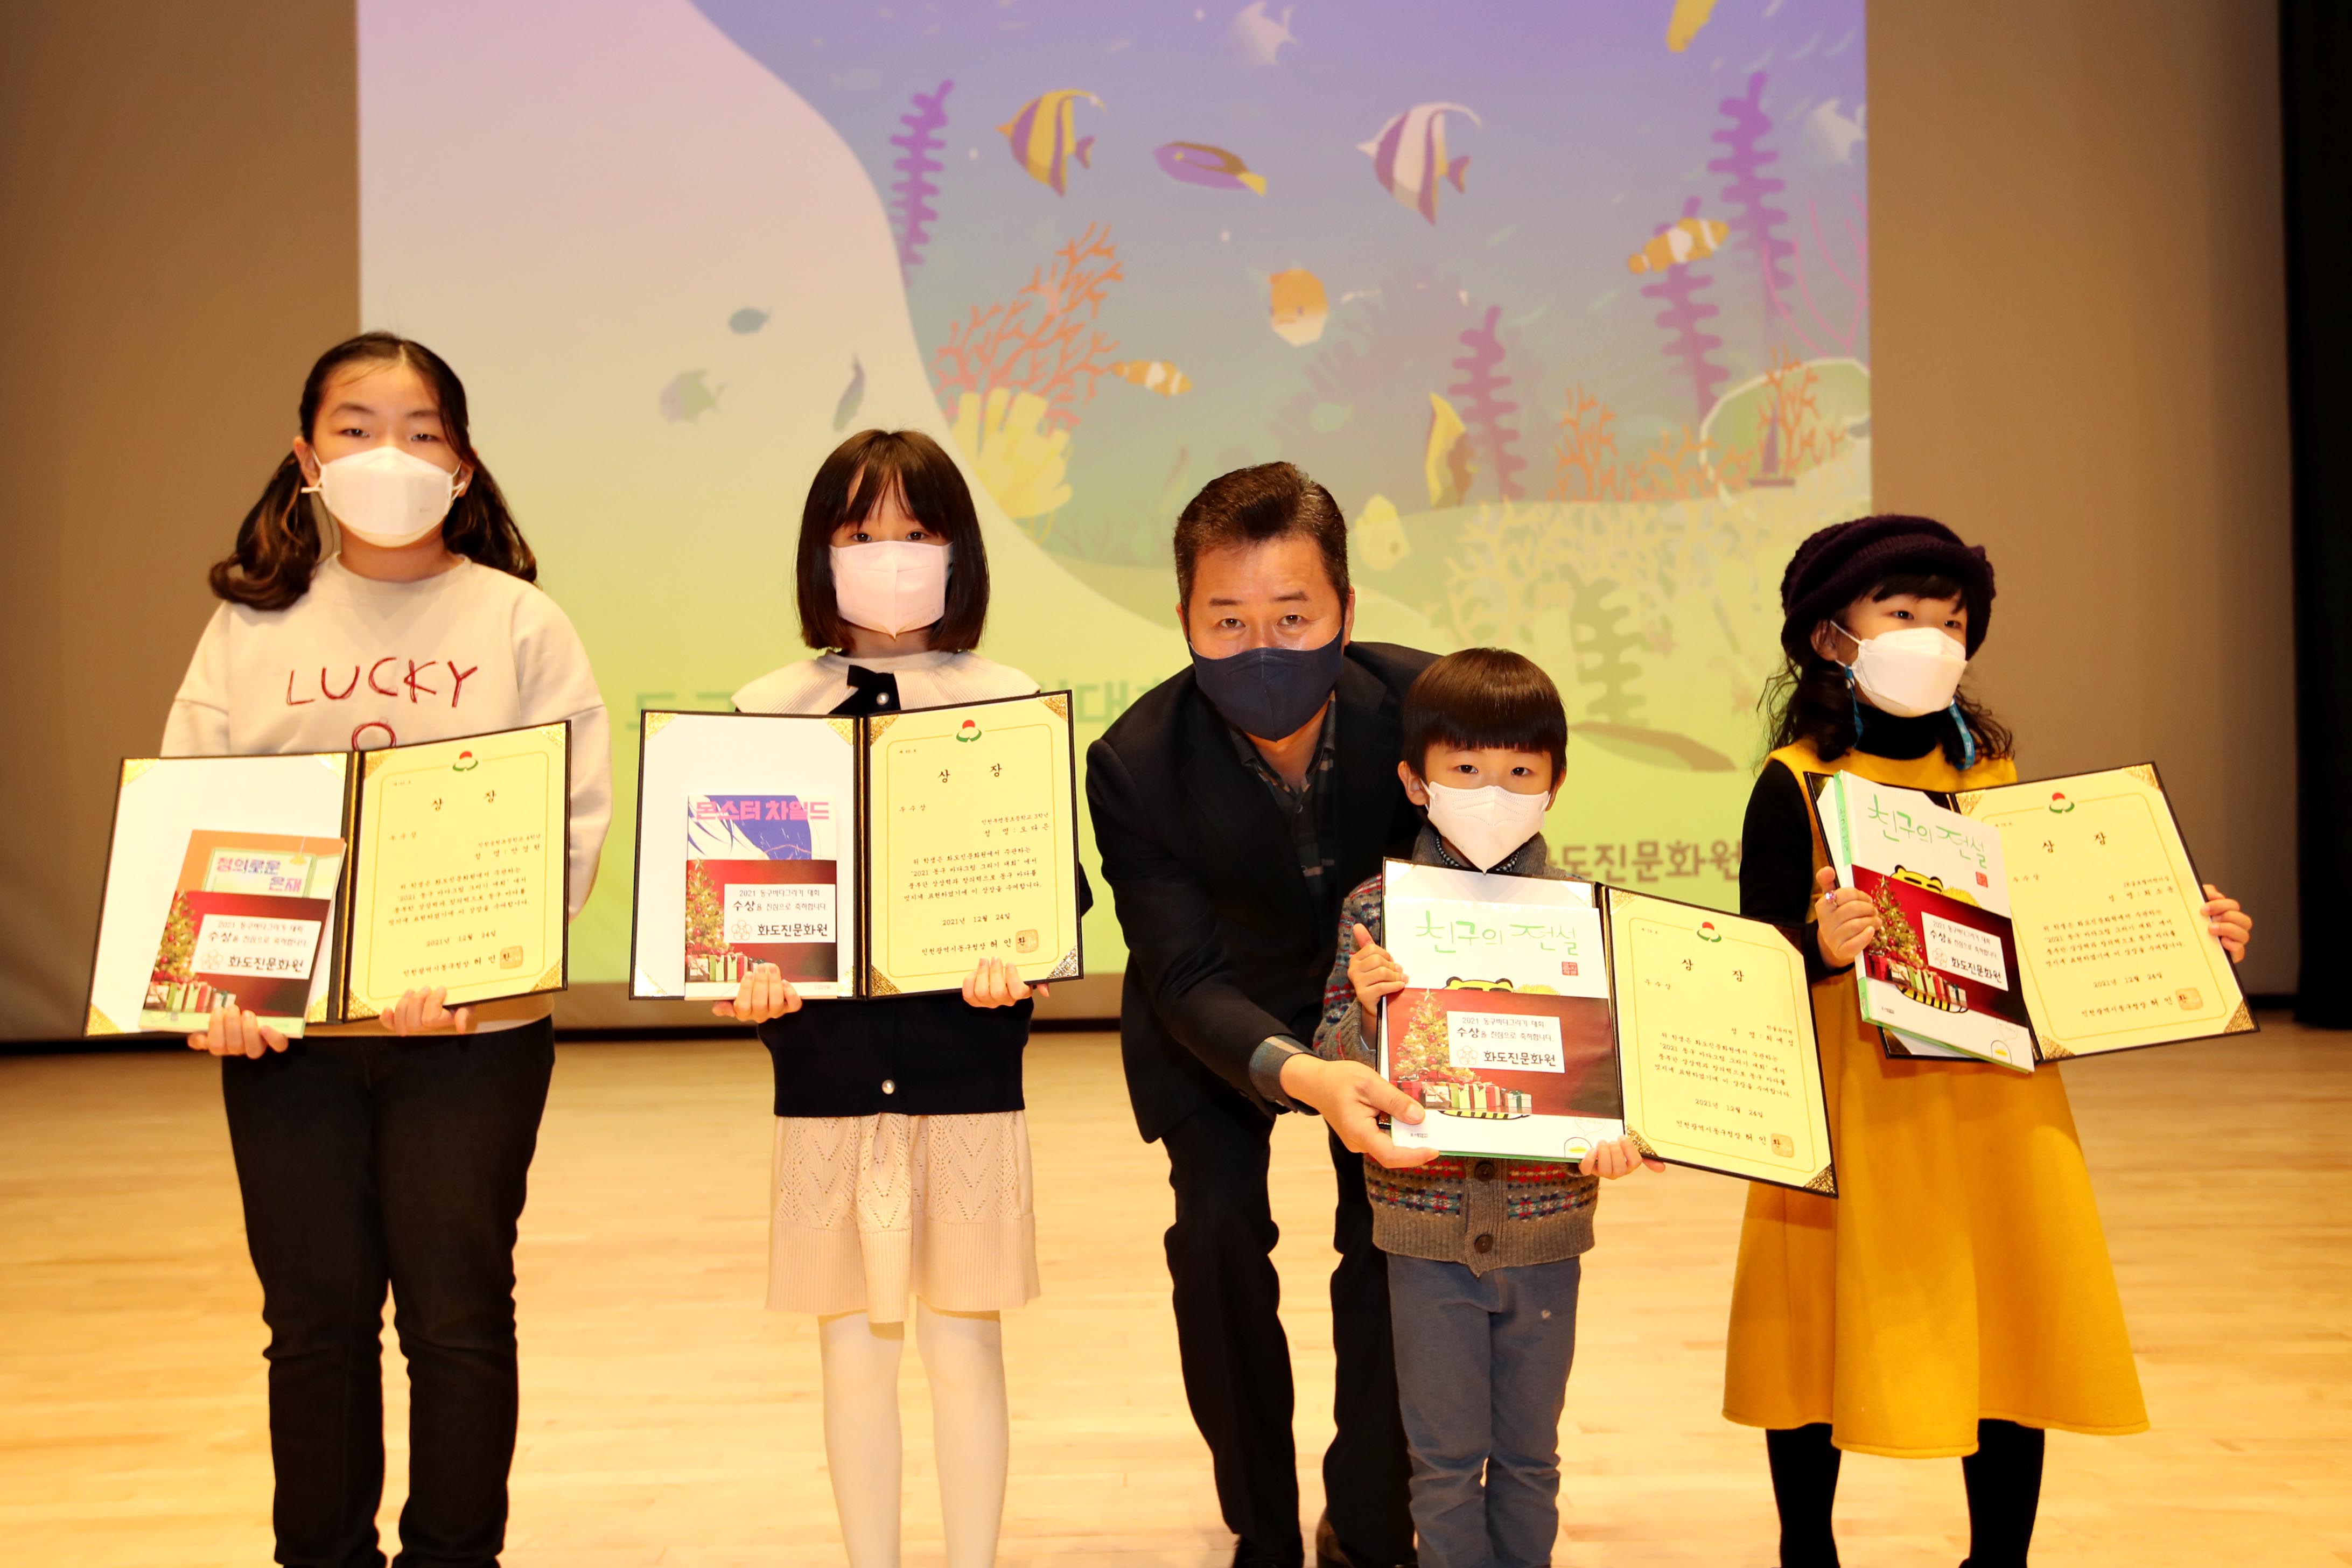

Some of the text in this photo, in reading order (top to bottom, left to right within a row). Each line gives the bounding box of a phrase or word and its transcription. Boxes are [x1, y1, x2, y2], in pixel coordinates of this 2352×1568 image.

[286, 657, 478, 708] LUCKY
[938, 763, 1002, 782] 상 장
[697, 800, 829, 821] 몬스터 차일드
[1868, 794, 1933, 844] 친구의
[1936, 825, 1987, 869] 전설
[1548, 840, 1741, 882] 도진문화원
[732, 901, 761, 911] 수상을
[758, 923, 827, 936] 화도진문화원
[942, 918, 965, 926] 2021년
[1416, 910, 1578, 955] 친구의 전설
[922, 943, 985, 955] 인천광역시동구청장
[991, 940, 997, 948] 허
[1004, 939, 1011, 947] 인
[1951, 956, 2001, 983] 화도진문화원
[1483, 1018, 1528, 1027] 동구바다그리기
[1531, 1020, 1544, 1028] 대회
[1457, 1028, 1554, 1042] 수상을 진심으로 축하합니다.
[1483, 1051, 1556, 1066] 화도진문화원
